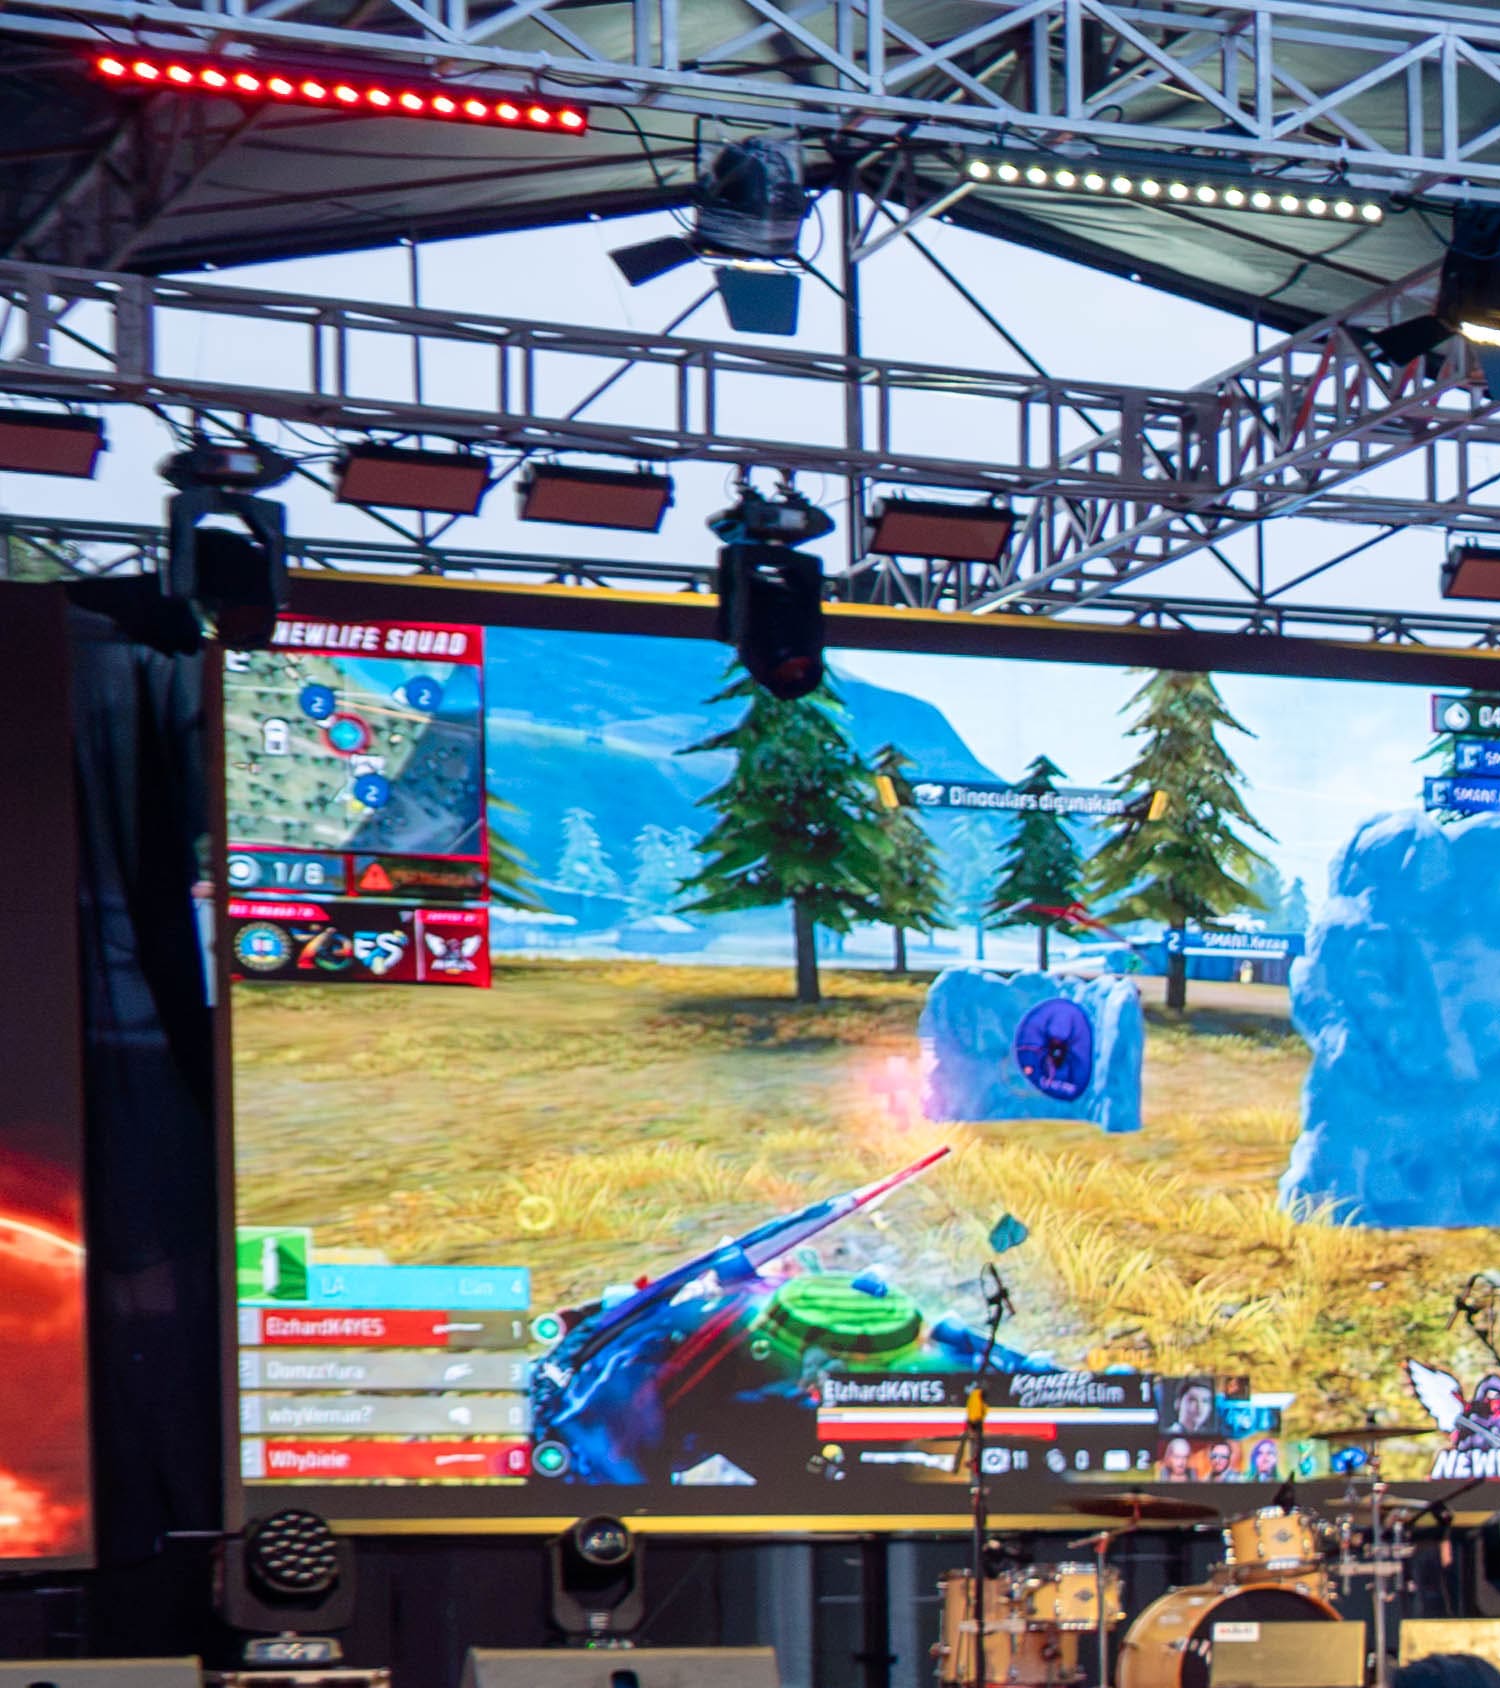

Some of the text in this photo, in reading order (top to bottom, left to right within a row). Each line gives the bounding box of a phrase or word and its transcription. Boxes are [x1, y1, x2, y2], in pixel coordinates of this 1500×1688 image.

[271, 620, 468, 656] NEWLIFE SQUAD
[272, 861, 326, 885] 1/8
